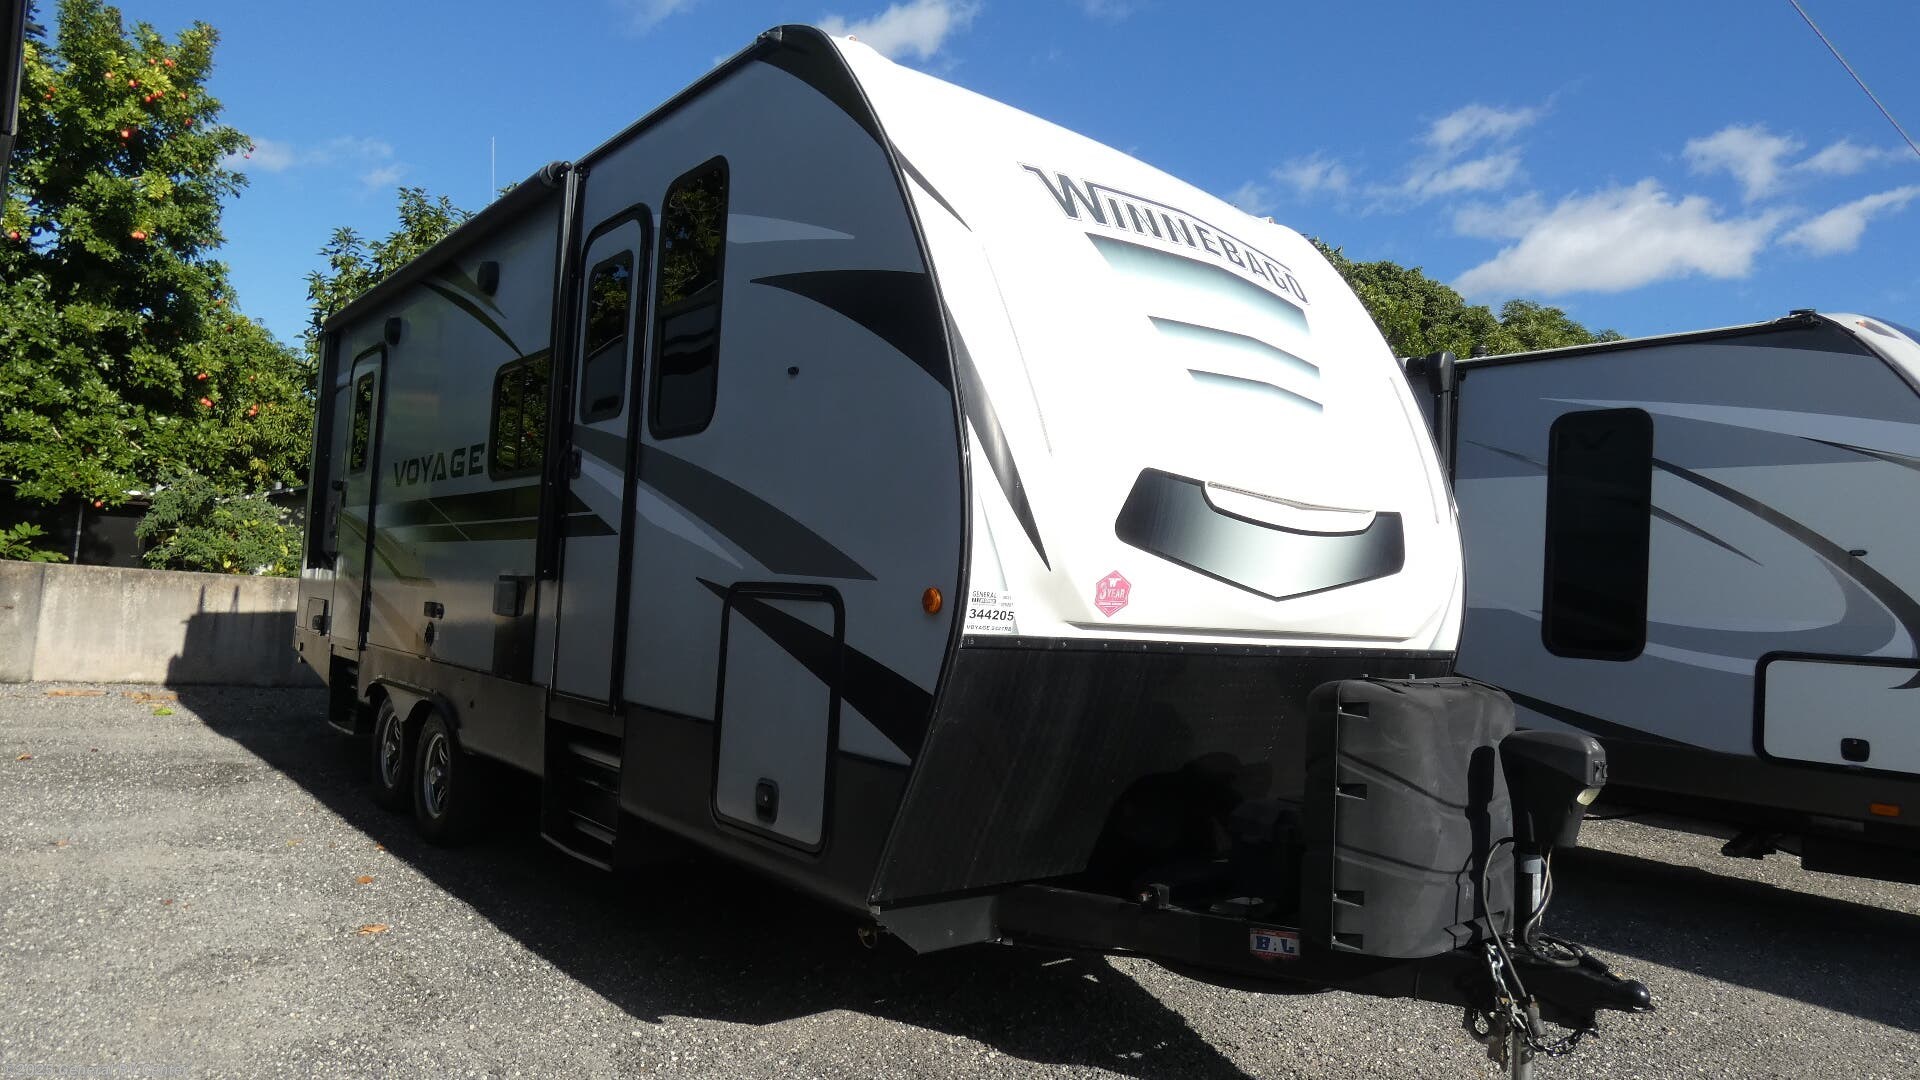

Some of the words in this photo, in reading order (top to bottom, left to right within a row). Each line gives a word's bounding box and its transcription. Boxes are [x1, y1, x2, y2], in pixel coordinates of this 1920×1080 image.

[1017, 161, 1310, 305] WINNEBAGO
[393, 443, 486, 487] VOYAGE
[972, 590, 997, 599] GENERAL
[969, 608, 1015, 621] 344205
[1256, 935, 1295, 953] BAL
